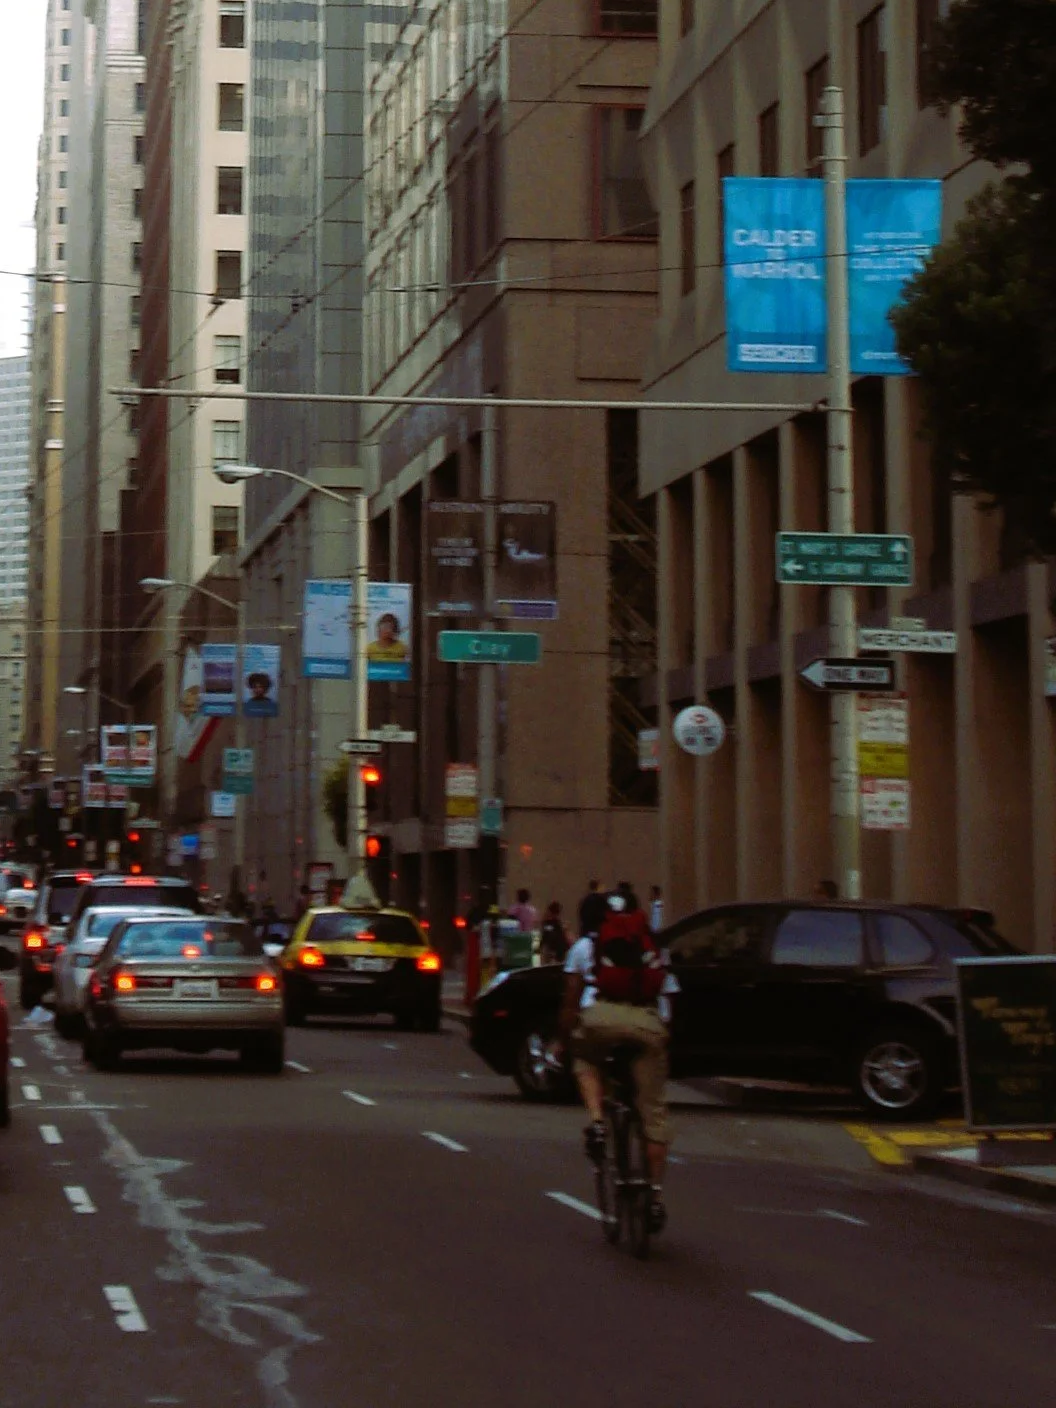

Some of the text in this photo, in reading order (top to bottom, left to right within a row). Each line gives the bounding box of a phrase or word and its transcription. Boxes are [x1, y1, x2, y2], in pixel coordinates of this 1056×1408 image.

[732, 228, 817, 247] CALDER
[731, 261, 821, 280] WARHOL
[467, 639, 512, 659] Clay
[861, 633, 954, 648] MERCHANT
[823, 668, 888, 681] ONE WAY
